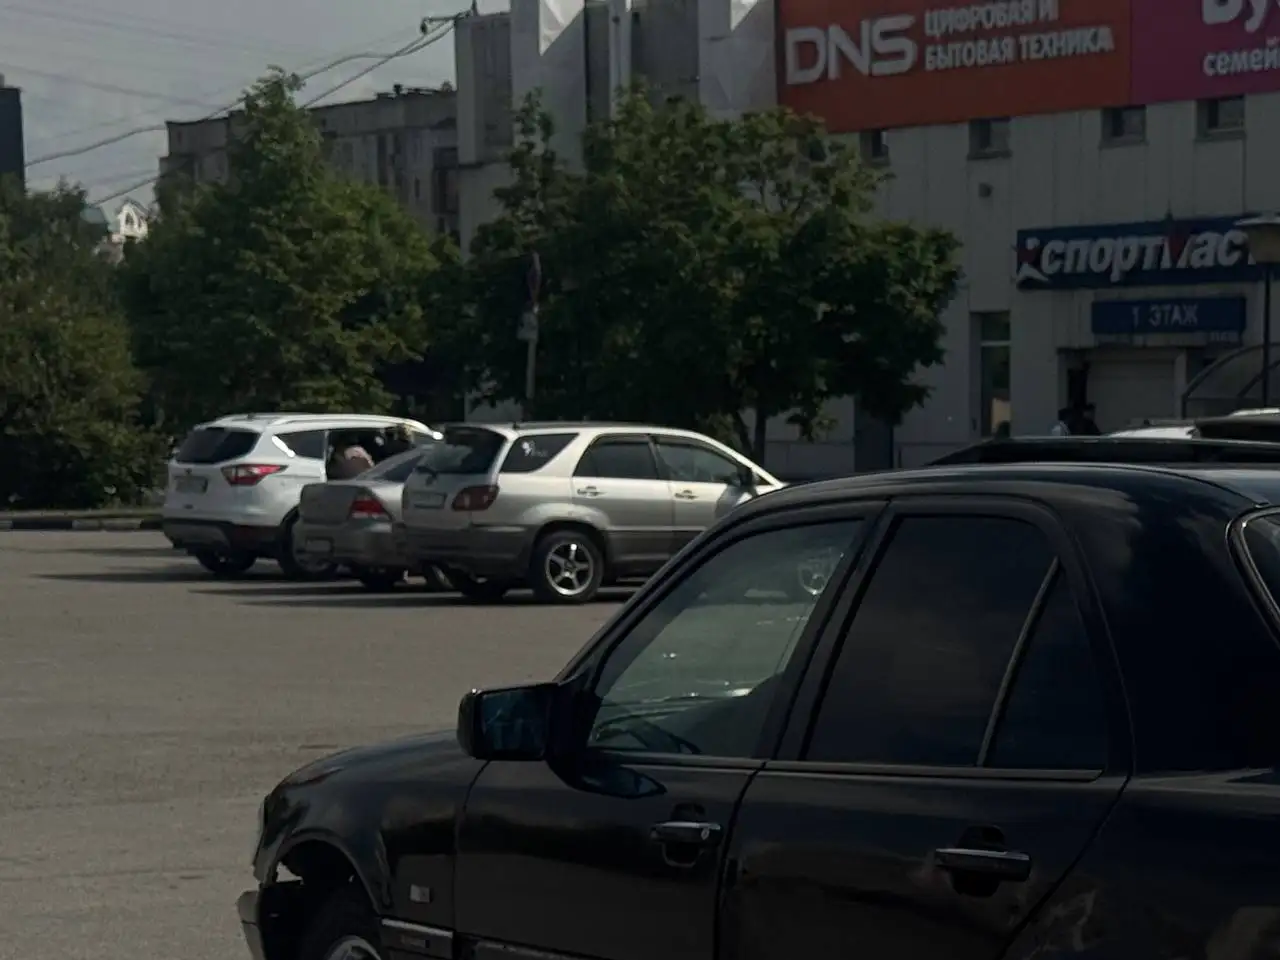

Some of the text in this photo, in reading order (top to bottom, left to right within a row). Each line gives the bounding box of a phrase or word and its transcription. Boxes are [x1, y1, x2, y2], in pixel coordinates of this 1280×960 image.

[924, 0, 1059, 39] ЦИФРОВАЯ И
[784, 14, 918, 86] DNS
[924, 25, 1115, 71] БЫТОВАЯ ТЕХНИКА
[1131, 304, 1199, 328] 1 ЭТАЖ
